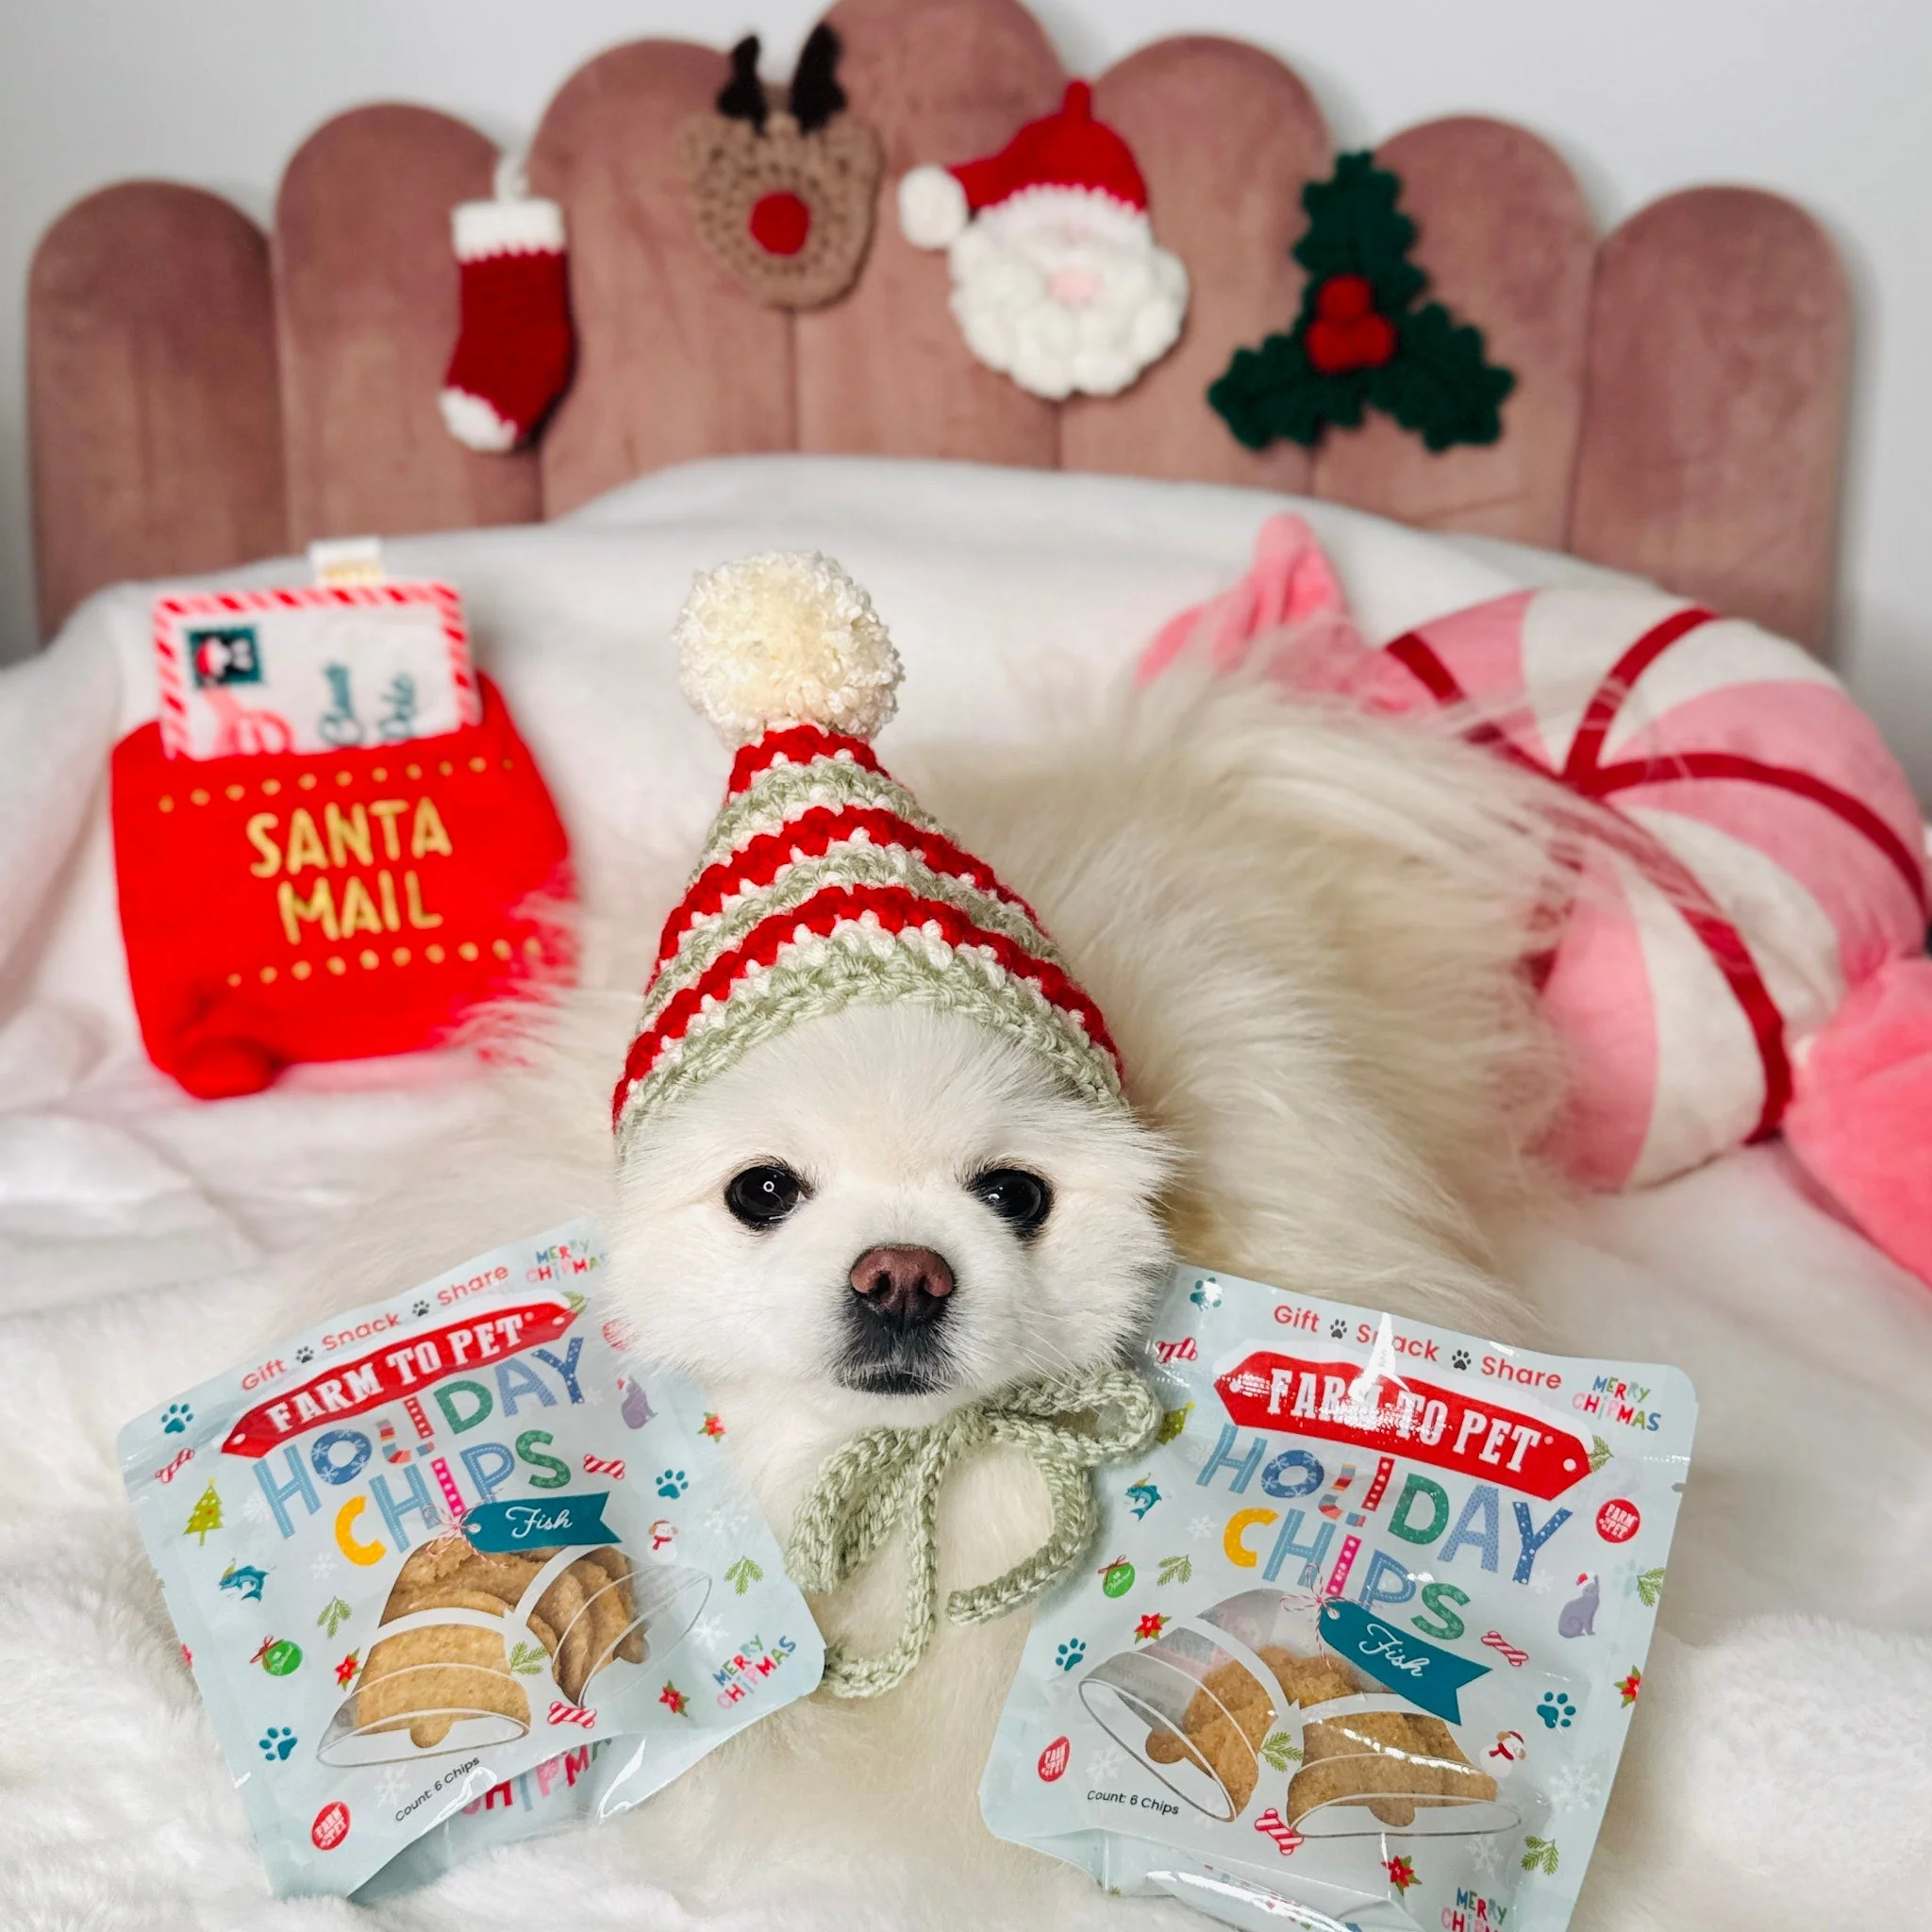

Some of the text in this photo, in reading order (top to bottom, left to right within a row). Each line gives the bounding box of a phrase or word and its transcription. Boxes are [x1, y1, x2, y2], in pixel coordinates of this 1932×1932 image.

[246, 797, 452, 877] SANTA
[277, 870, 443, 944] MAIL
[536, 1239, 590, 1265] MERRY
[241, 1266, 508, 1391] Gift Snack Share
[1274, 1306, 1320, 1333] Gift
[1481, 1356, 1562, 1390] Share
[266, 1314, 524, 1434] FARM TO PET
[1592, 1375, 1651, 1404] MERRY
[252, 1337, 584, 1539] HOLIDAY
[1396, 1391, 1449, 1446] TO
[1453, 1409, 1541, 1473] PET
[506, 1506, 573, 1539] Fish
[1195, 1423, 1574, 1585] HOLIDAY
[712, 1634, 763, 1686] MERRY
[1358, 1624, 1430, 1676] Fish
[434, 1780, 443, 1791] 6
[444, 1757, 480, 1785] Chips
[1129, 1794, 1139, 1806] 6
[1141, 1797, 1179, 1816] Chips
[1456, 1887, 1507, 1925] MERRY
